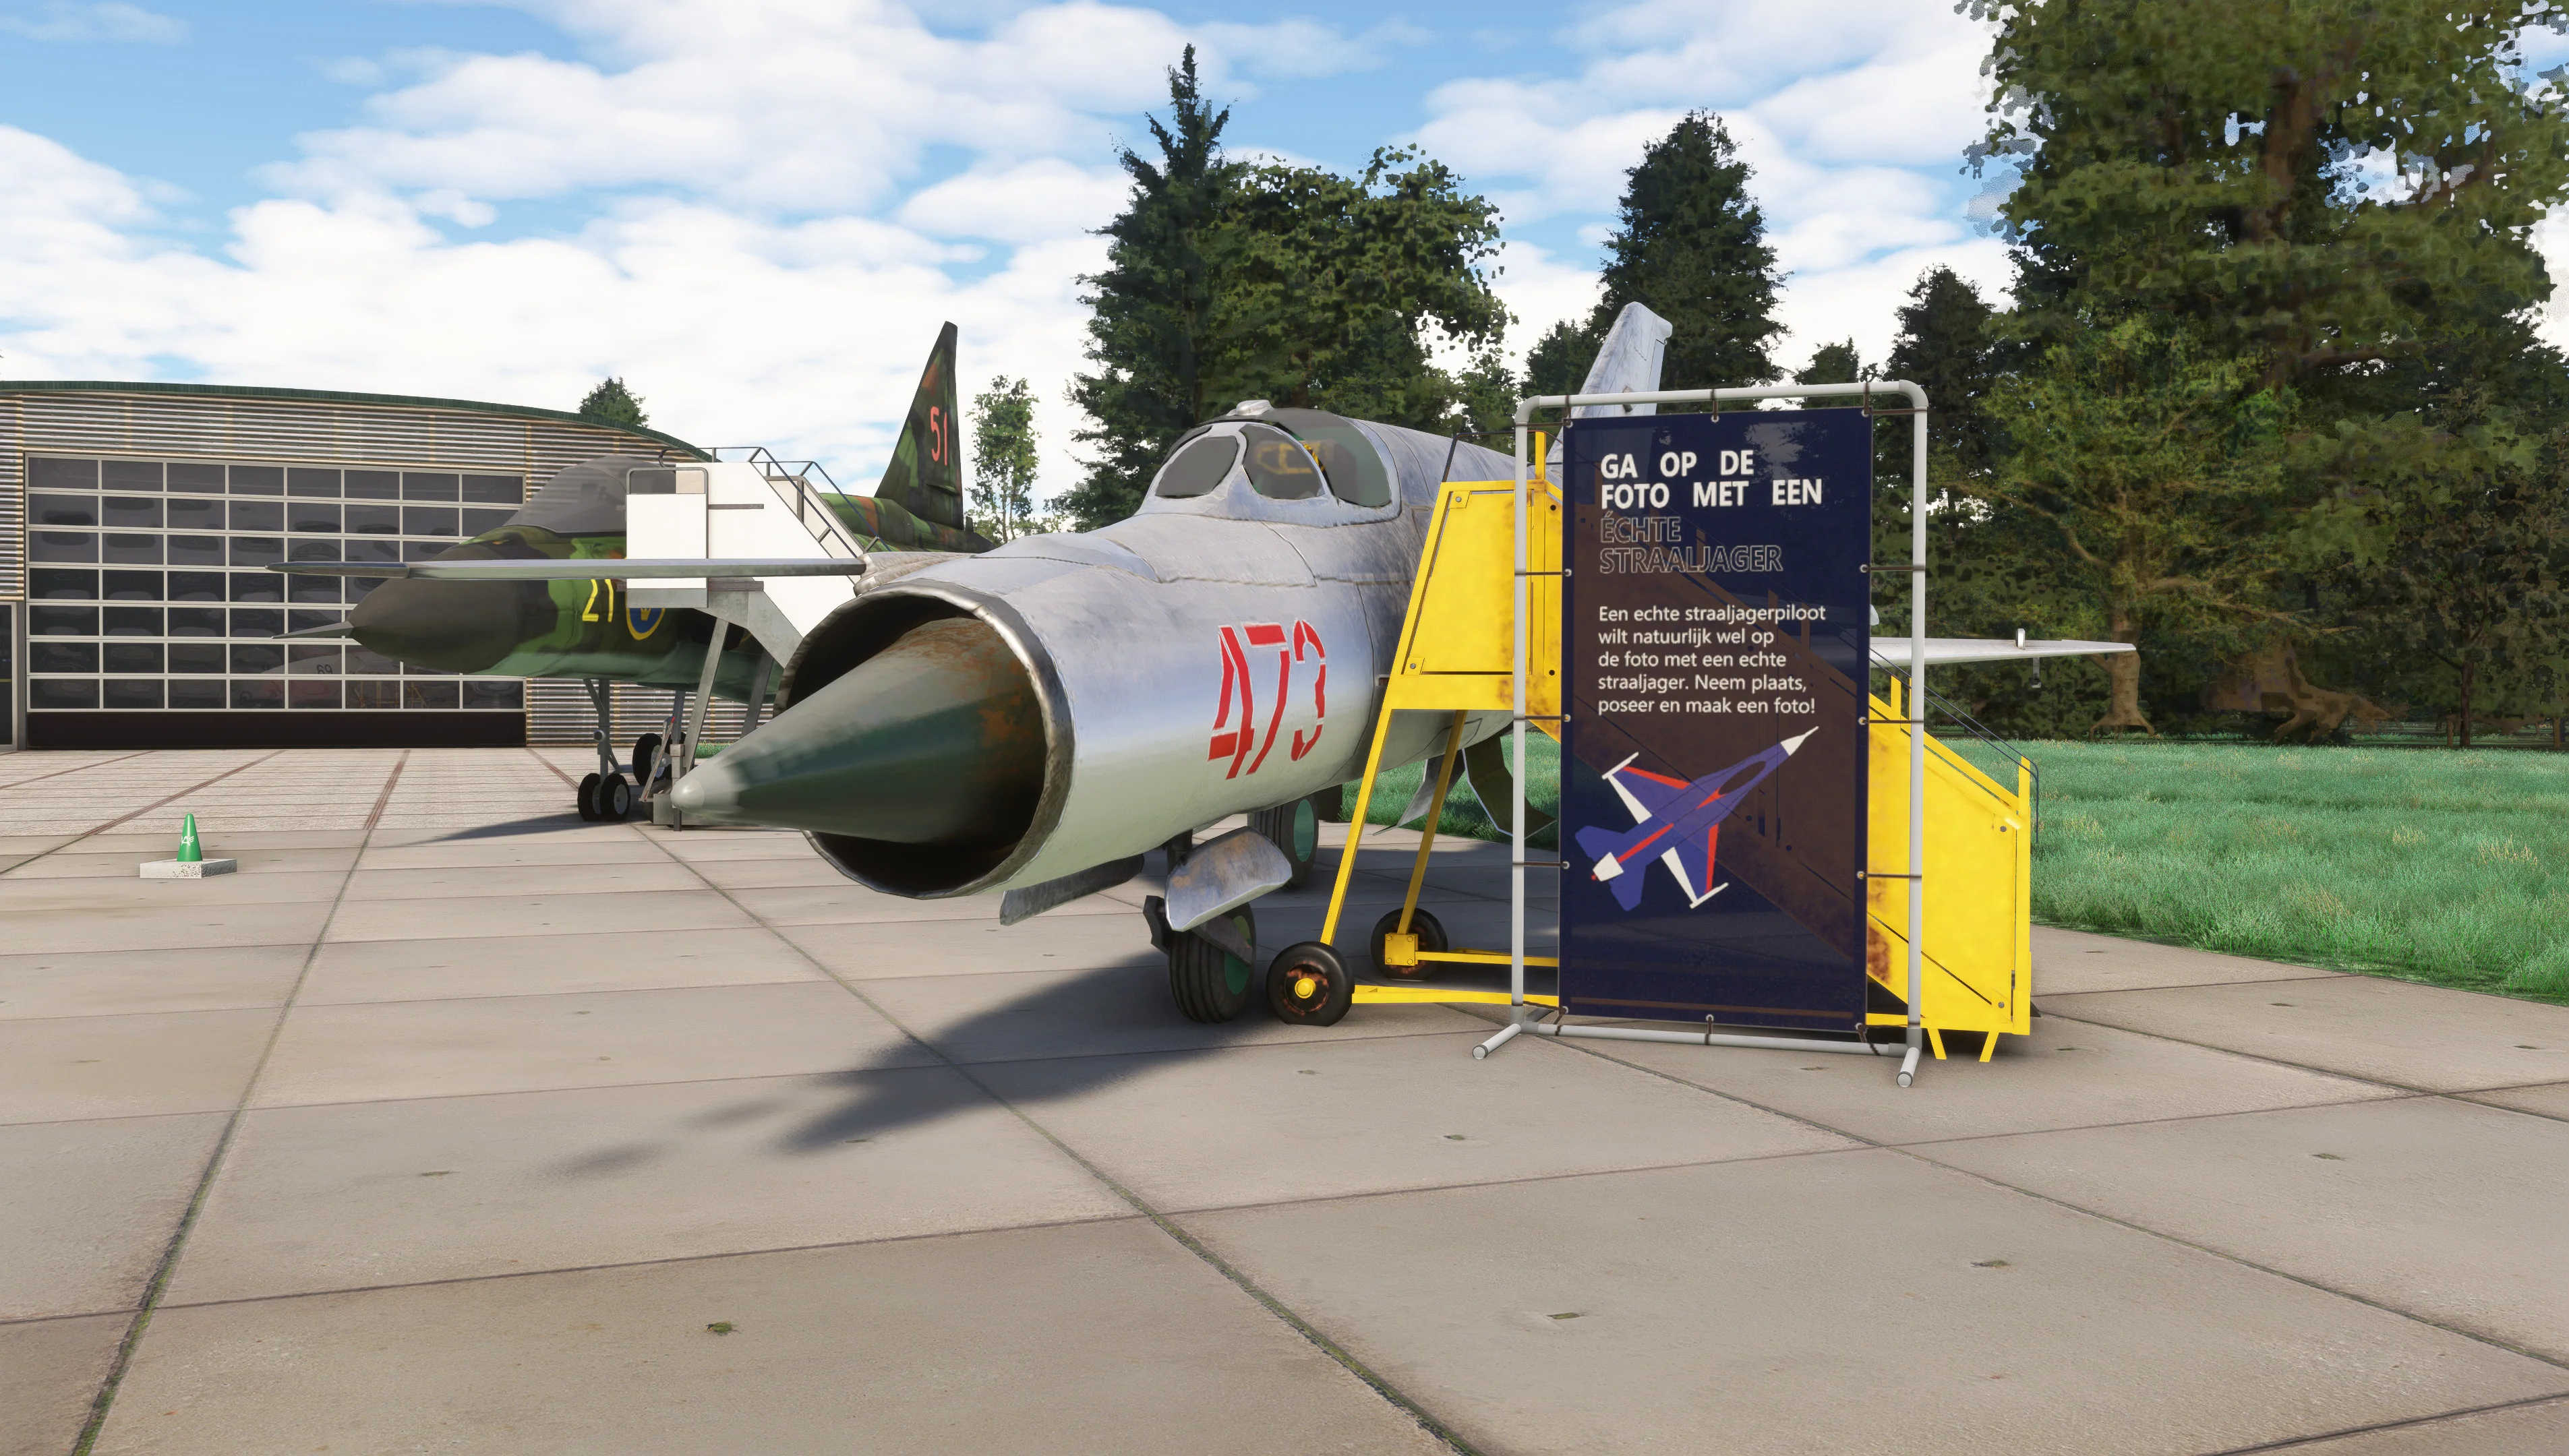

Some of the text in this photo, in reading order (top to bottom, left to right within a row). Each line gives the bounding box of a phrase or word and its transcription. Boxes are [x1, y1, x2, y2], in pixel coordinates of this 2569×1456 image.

[931, 406, 947, 466] 51
[1600, 450, 1753, 479] GA OP DE
[1601, 479, 1822, 510] FOTO MET EEN
[1600, 510, 1682, 543] ÉCHTE
[1599, 545, 1784, 574] STRAALJAGER
[1599, 605, 1827, 624] Een echte straaljagerpiloot
[1598, 628, 1774, 648] wilt natuurlijk wel op
[1598, 650, 1787, 667] de foto met een echte
[1598, 674, 1807, 694] straaljager. Neem plaats,
[1208, 618, 1326, 781] 473
[1599, 697, 1816, 716] poseer en maak een foto!
